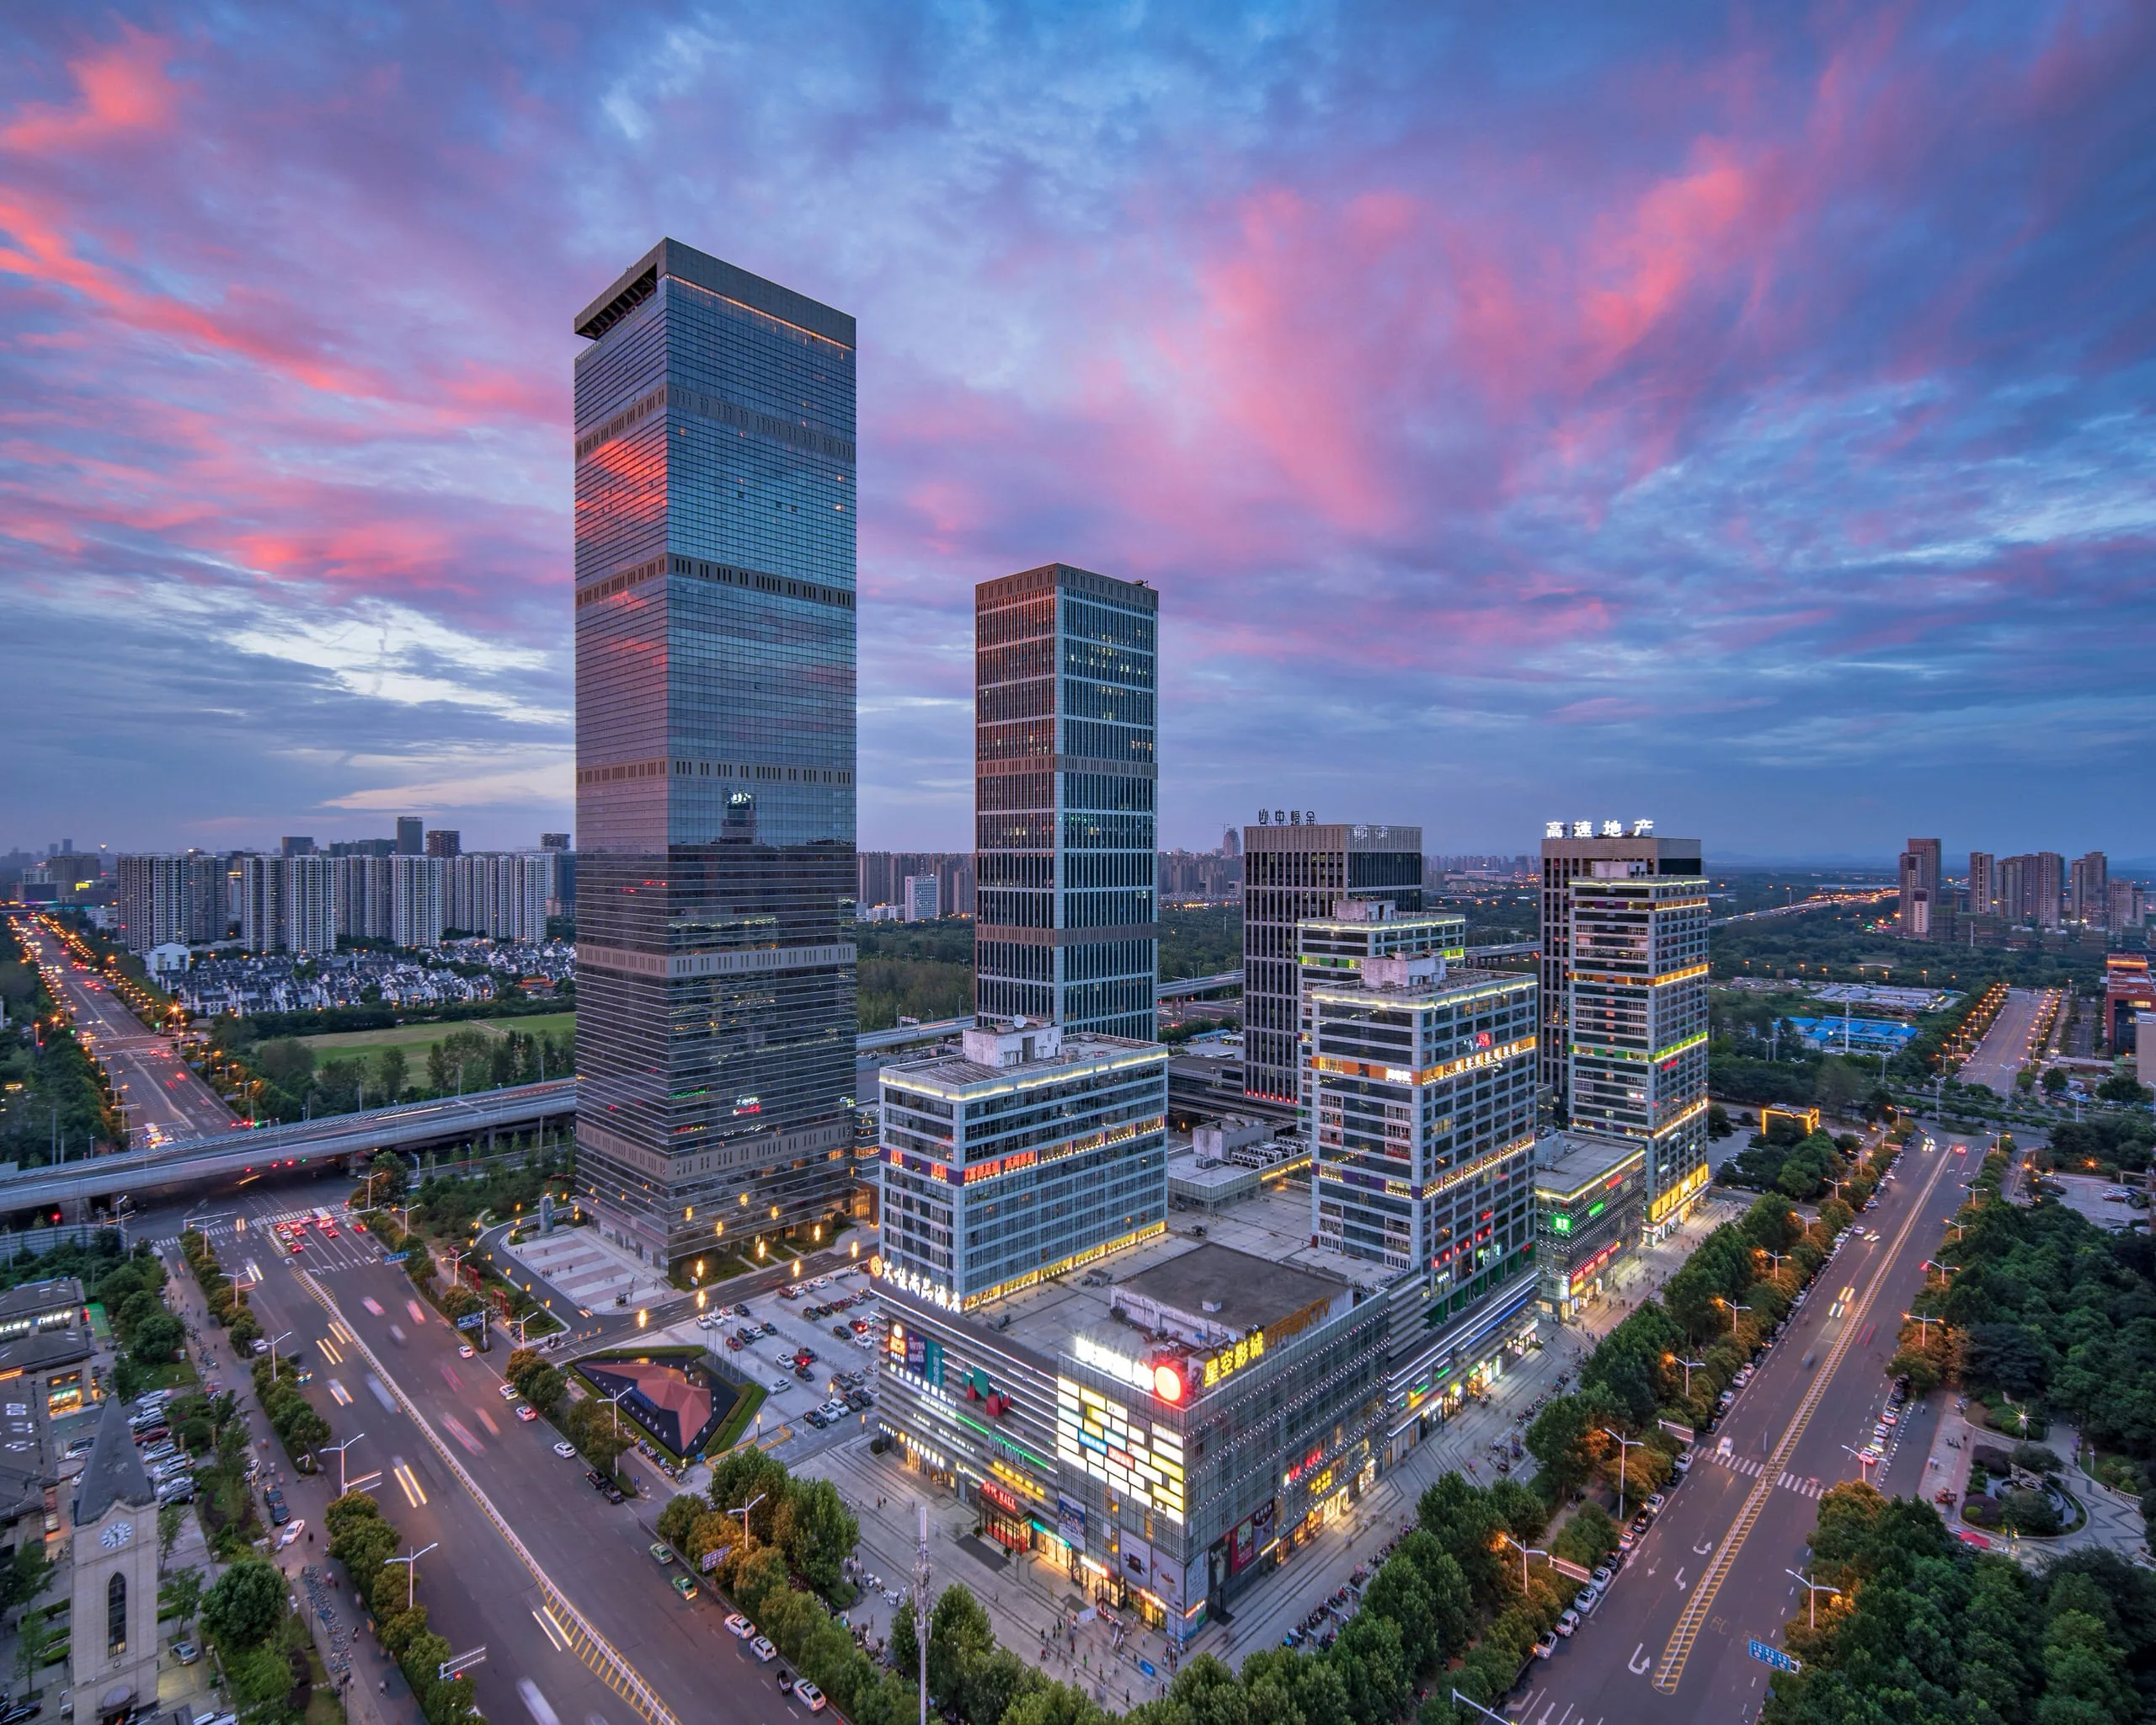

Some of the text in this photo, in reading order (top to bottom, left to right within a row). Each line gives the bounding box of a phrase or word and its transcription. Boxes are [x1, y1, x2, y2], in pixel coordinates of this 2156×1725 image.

[1545, 820, 1654, 839] 高速地产
[1203, 1331, 1264, 1388] 星空影城
